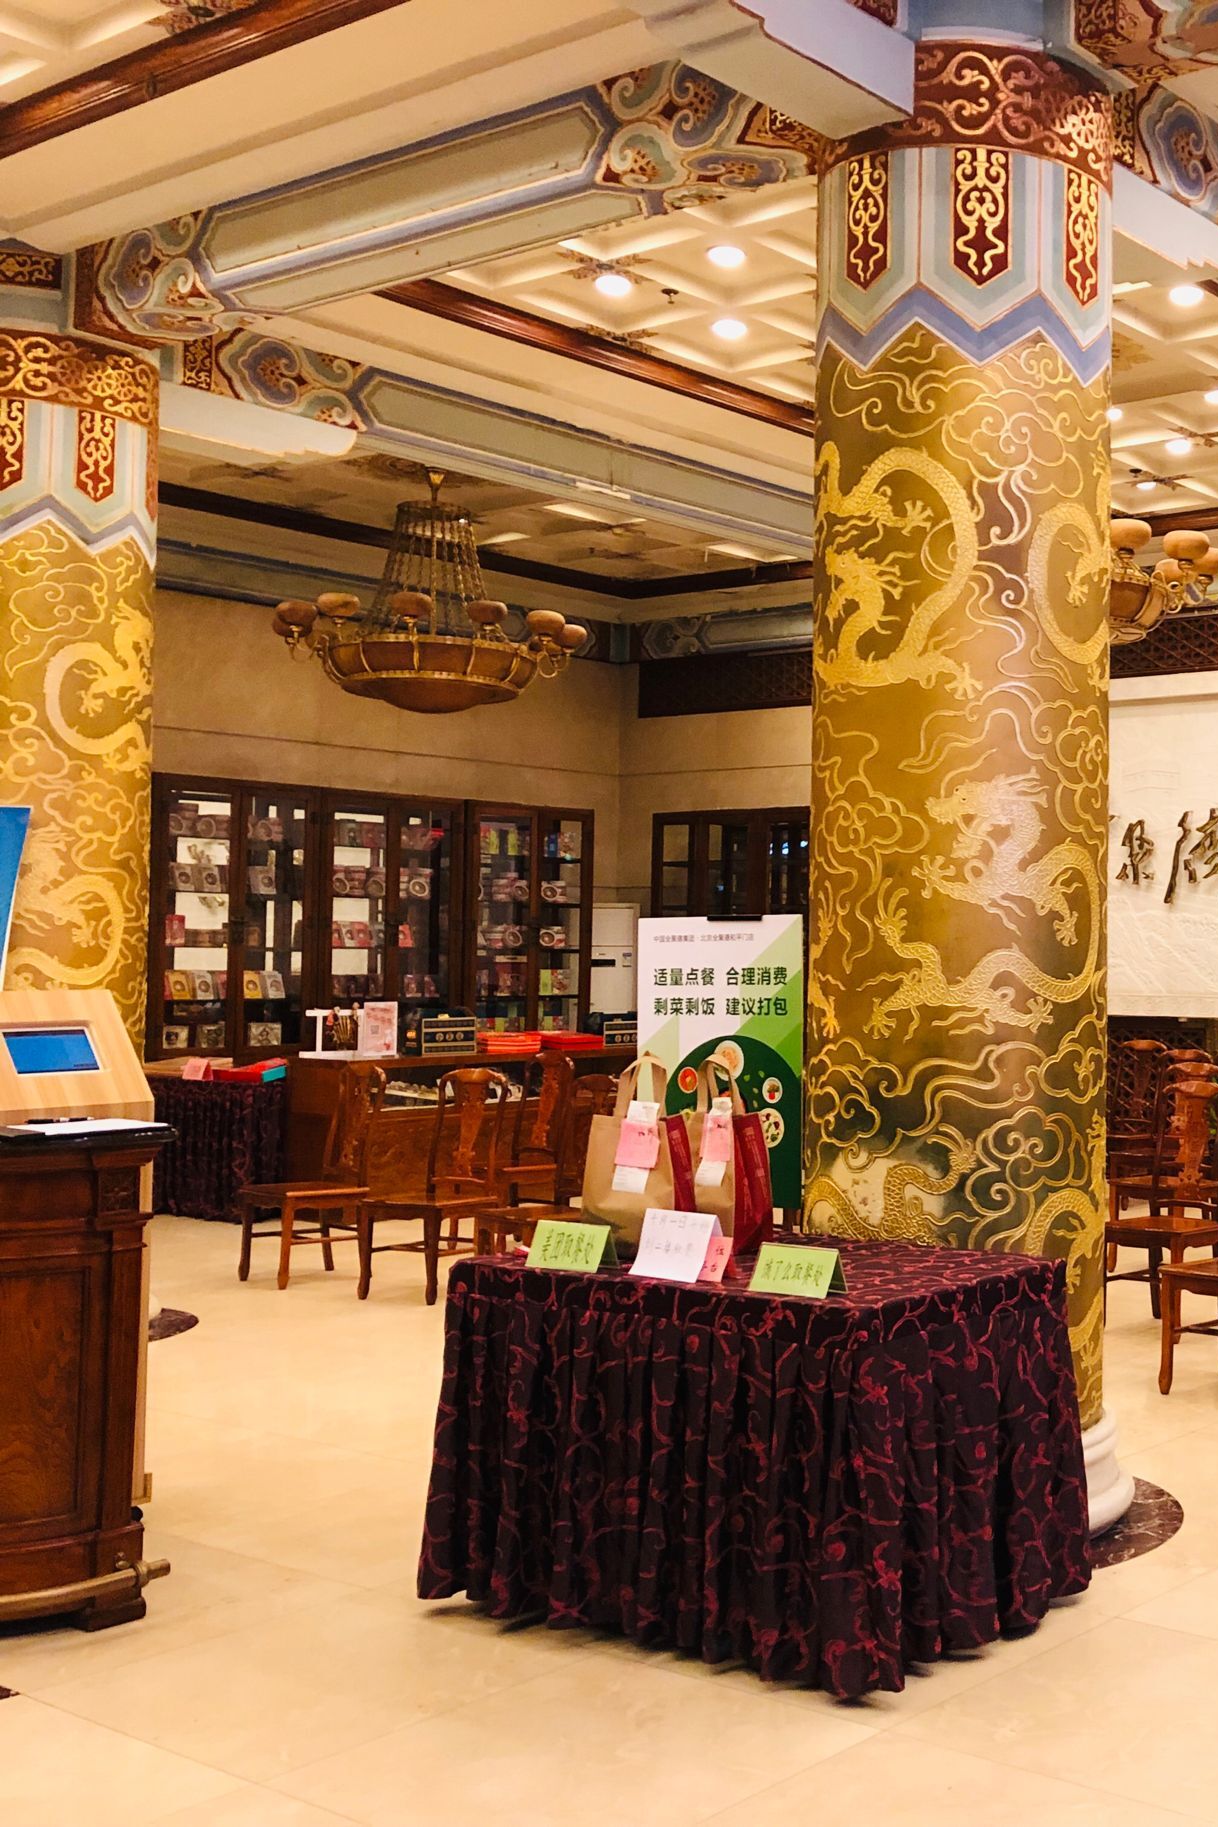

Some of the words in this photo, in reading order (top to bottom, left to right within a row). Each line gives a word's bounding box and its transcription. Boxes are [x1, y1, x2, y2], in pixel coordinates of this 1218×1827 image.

[653, 967, 715, 986] 适量点餐
[725, 966, 788, 986] 合理消费
[653, 997, 716, 1016] 剩菜剩饭
[725, 997, 788, 1016] 建议打包
